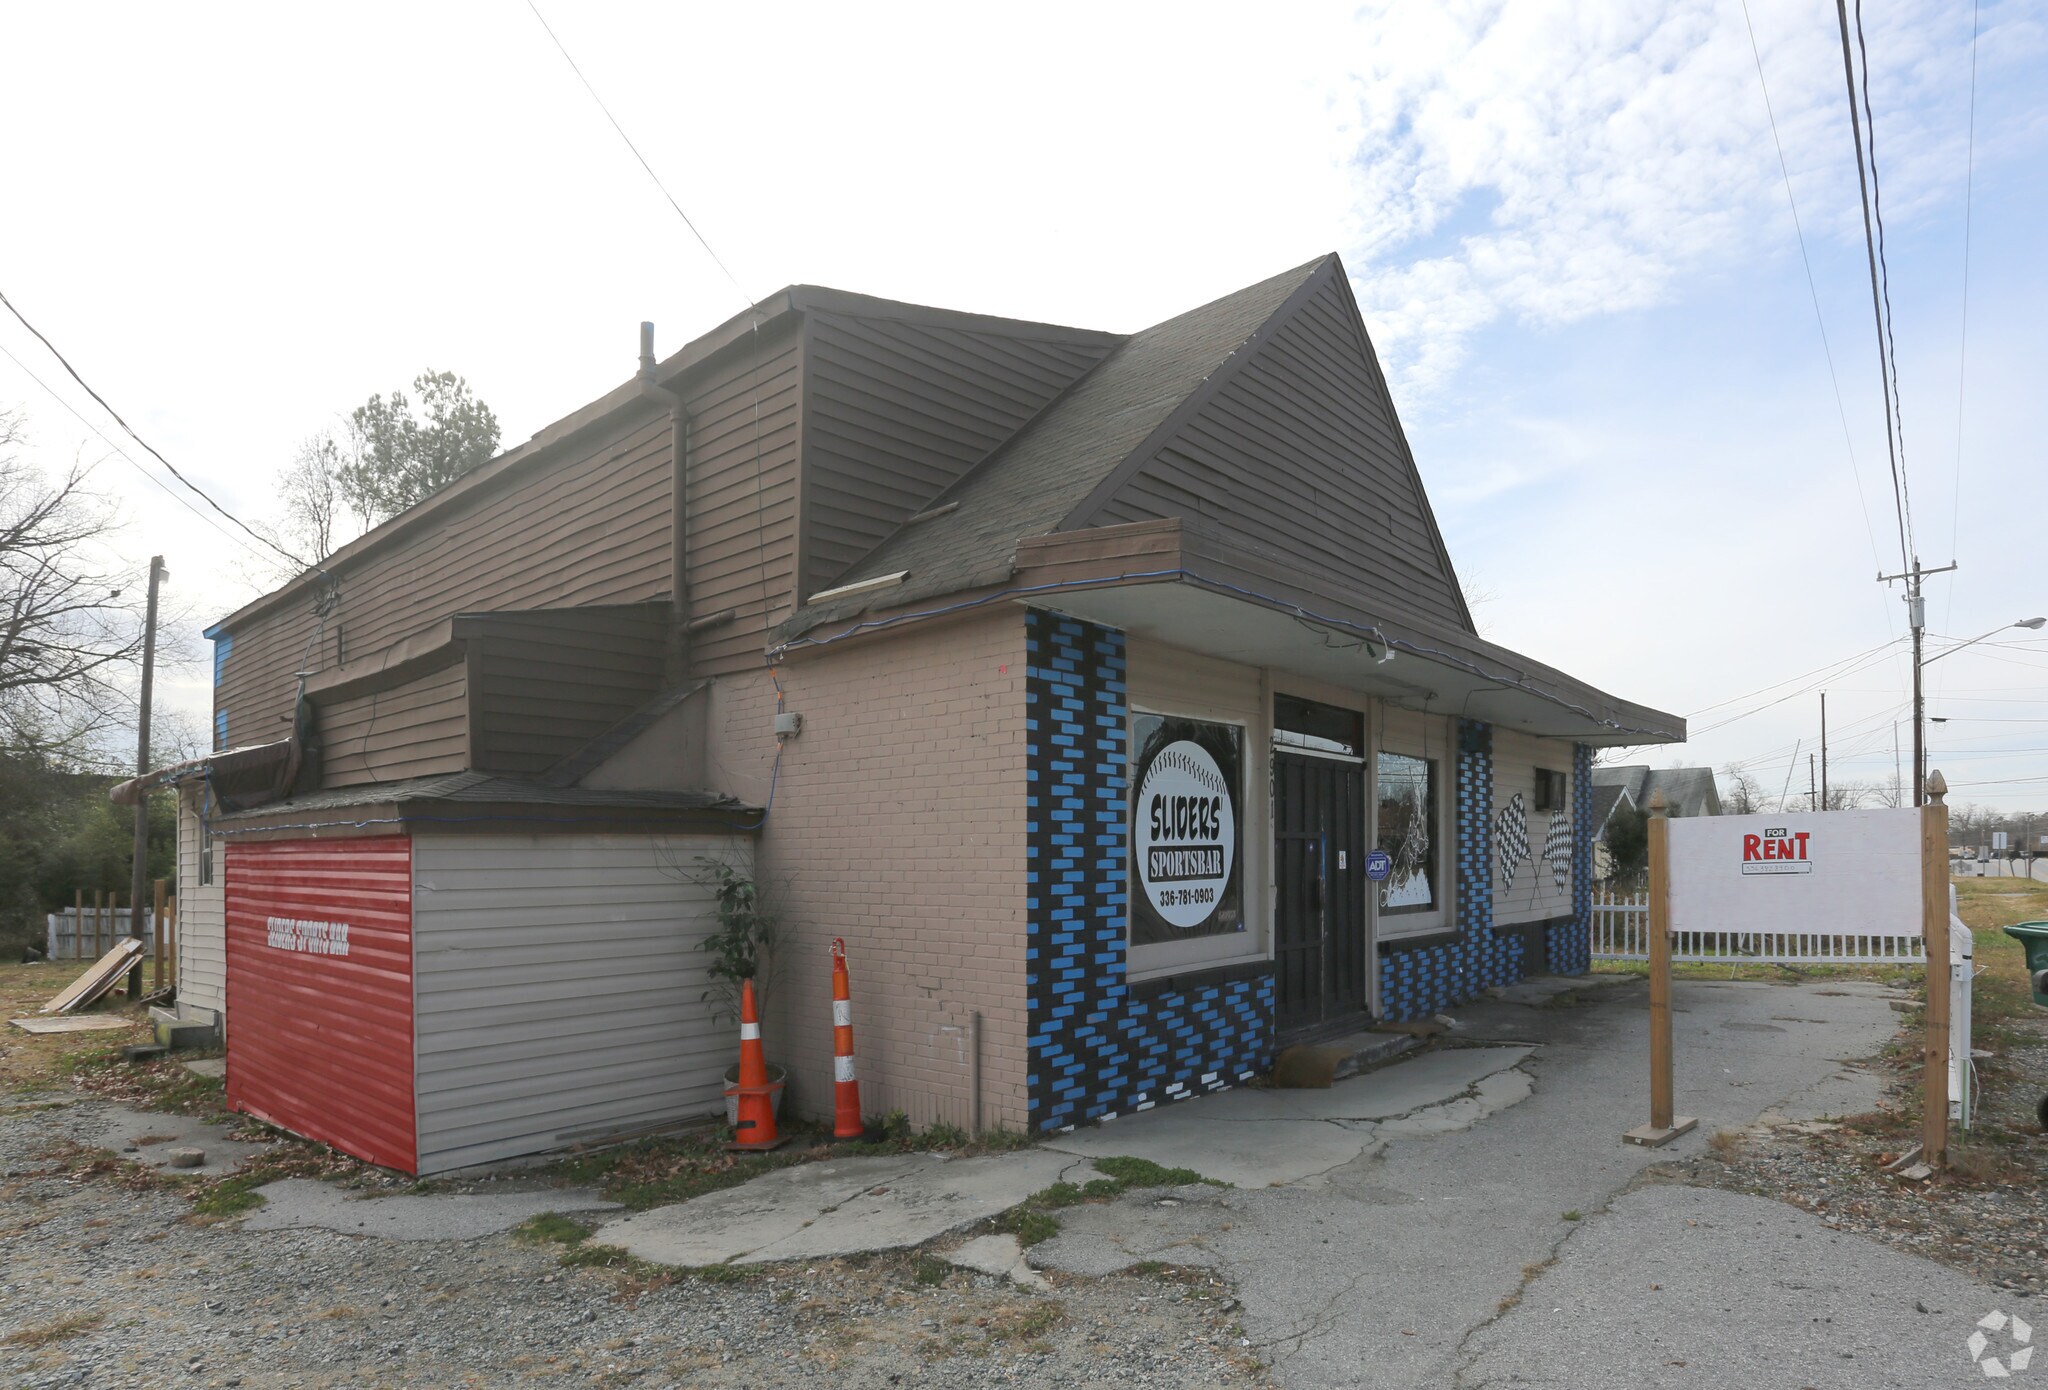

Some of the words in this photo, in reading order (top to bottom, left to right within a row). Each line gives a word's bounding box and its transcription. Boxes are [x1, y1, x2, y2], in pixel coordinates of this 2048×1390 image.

[1743, 832, 1810, 861] RENT
[1369, 860, 1386, 872] ADT
[1160, 887, 1214, 907] 336-781-0903
